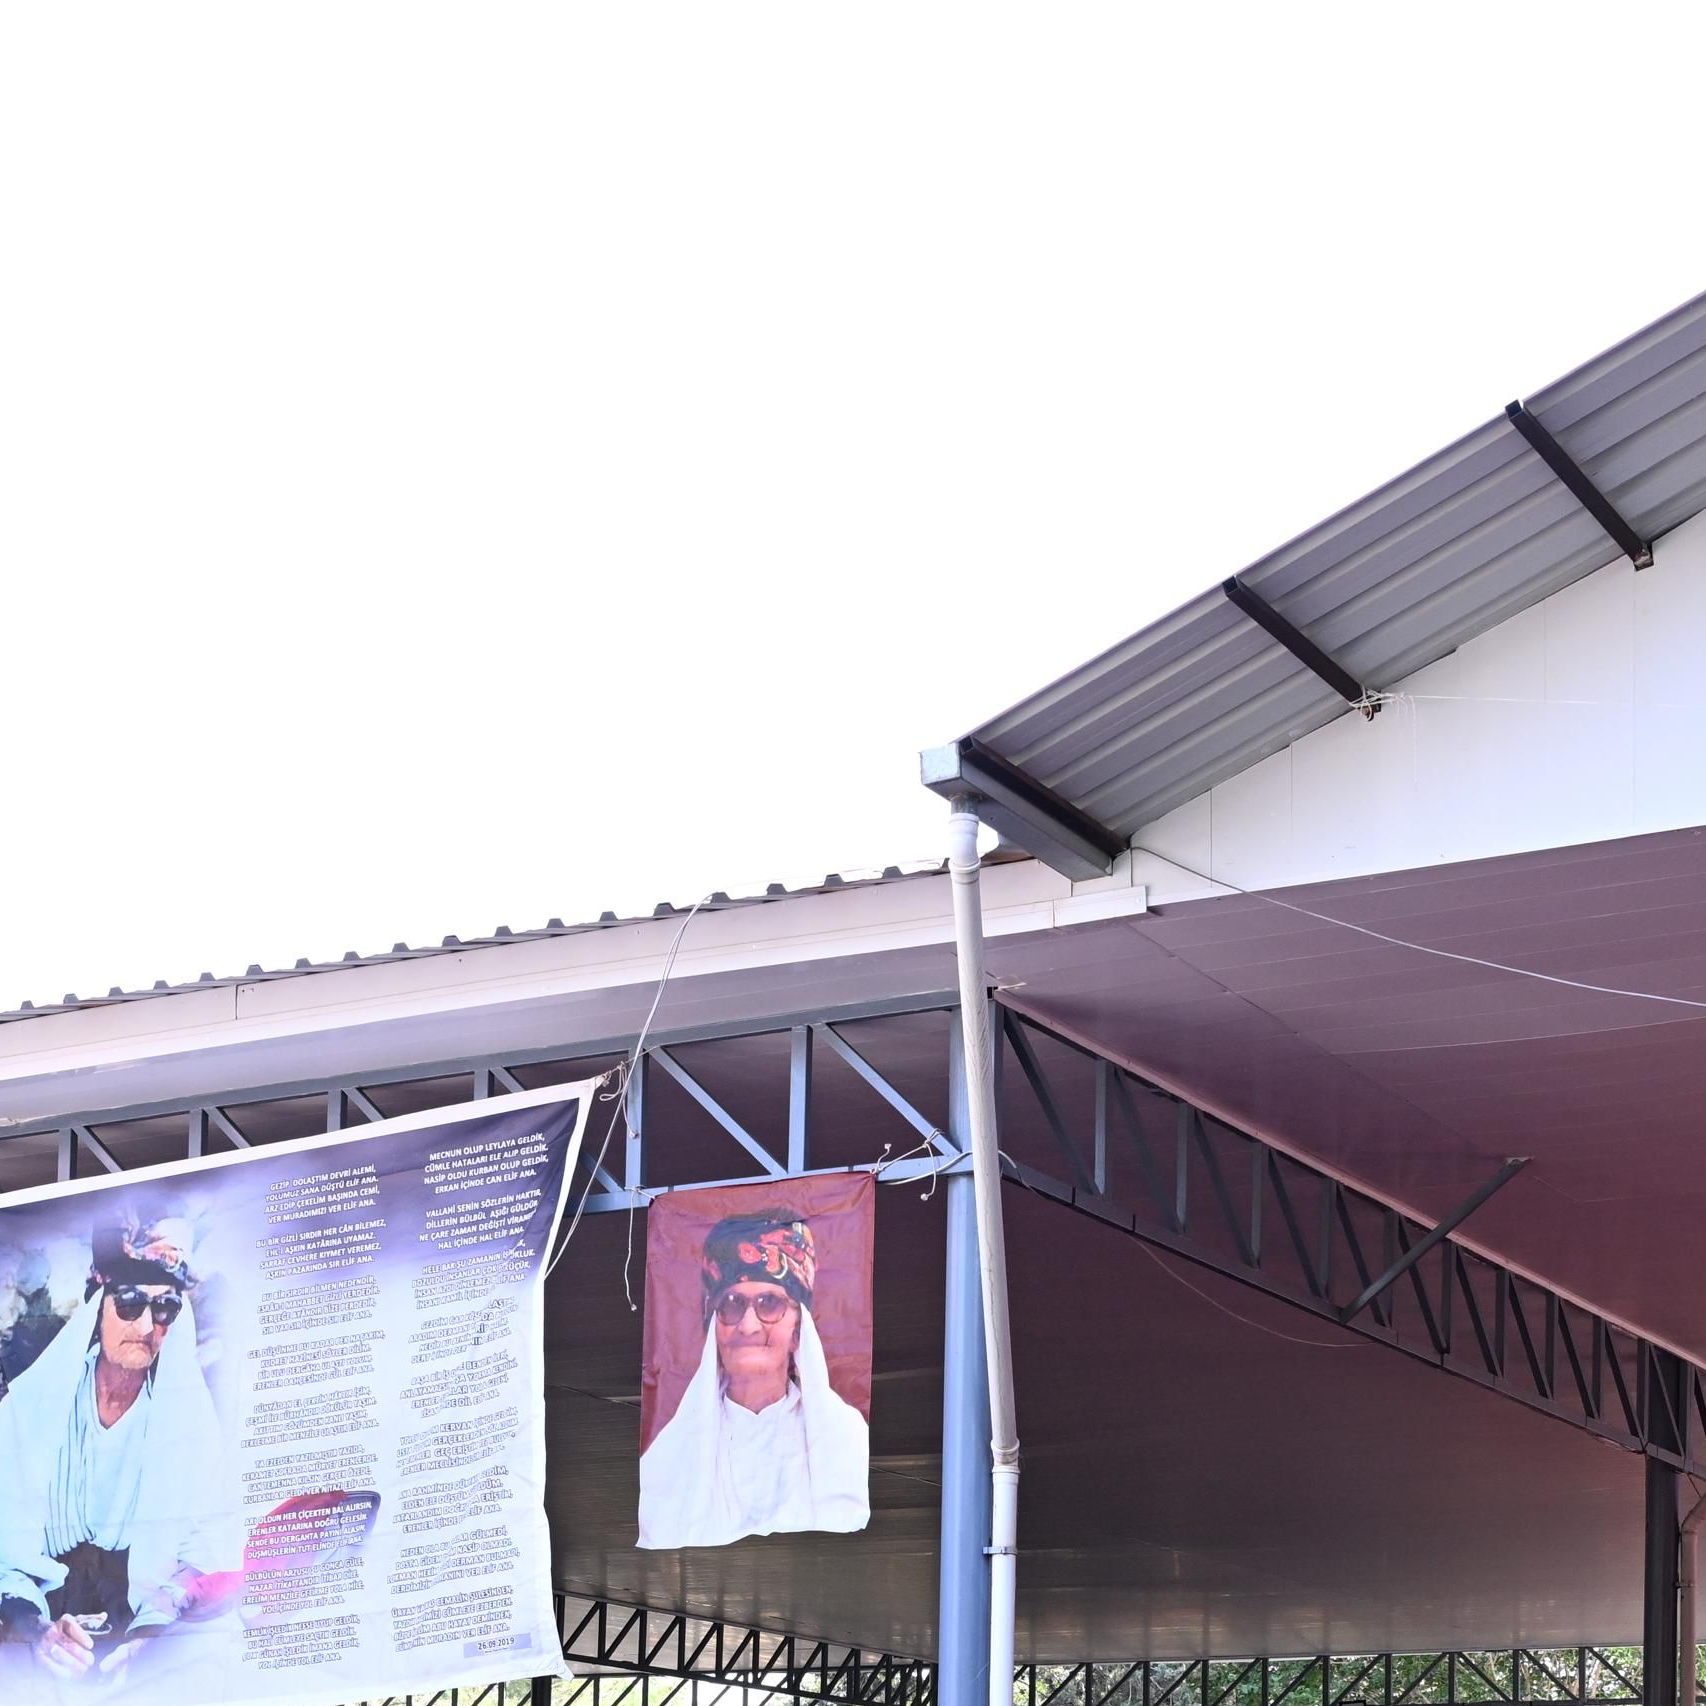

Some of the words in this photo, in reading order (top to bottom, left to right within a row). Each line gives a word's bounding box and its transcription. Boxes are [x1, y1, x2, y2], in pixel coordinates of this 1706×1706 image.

[424, 1160, 451, 1174] CÜMLE
[452, 1155, 488, 1168] HATALARI
[490, 1153, 502, 1162] ELE
[503, 1149, 519, 1159] ALIP
[520, 1142, 549, 1156] GELDİK.
[429, 1148, 462, 1162] MECNUN
[463, 1144, 484, 1155] OLUP
[485, 1139, 516, 1151] LEYLAYA
[517, 1131, 545, 1146] GELDİK,
[270, 1180, 290, 1191] GEZİP
[293, 1174, 328, 1188] DOLAŞTIM
[329, 1169, 351, 1180] DEVRİ
[352, 1164, 377, 1177] ALEMİ,
[424, 1173, 446, 1185] NASİP
[447, 1170, 468, 1180] OLDU
[469, 1165, 499, 1176] KURBAN
[500, 1161, 521, 1171] OLUP
[522, 1153, 549, 1167] GELDİK,
[435, 1183, 459, 1194] ERKAN
[460, 1177, 485, 1191] İÇİNDE
[486, 1175, 502, 1185] CAN
[503, 1170, 519, 1182] ELİF
[519, 1169, 537, 1179] ANA.
[265, 1205, 279, 1213] ARZ
[280, 1201, 296, 1211] EDİP
[297, 1195, 326, 1209] ÇEKELİM
[327, 1191, 359, 1204] BAŞINDA
[360, 1185, 381, 1197] CEMİ,
[266, 1190, 300, 1202] YOLUMUZ
[300, 1187, 320, 1196] SANA
[321, 1181, 345, 1194] DÜŞTÜ
[346, 1178, 360, 1188] ELİF
[360, 1176, 379, 1185] ANA.
[269, 1215, 283, 1224] VER
[283, 1207, 327, 1222] MURADIMIZI
[328, 1205, 342, 1214] VER
[343, 1200, 359, 1211] ELİF
[359, 1199, 377, 1209] ANA.
[426, 1205, 456, 1219] VALLAHİ
[457, 1201, 480, 1213] SENİN
[480, 1194, 514, 1208] SÖZLERİN
[426, 1215, 458, 1230] DİLLERİN
[459, 1210, 488, 1223] BÜLBÜL
[489, 1205, 509, 1219] AŞIĞI
[256, 1240, 267, 1248] BU
[268, 1236, 280, 1246] BİR
[281, 1233, 299, 1244] GİZLİ
[299, 1231, 322, 1241] SIRDIR
[323, 1228, 338, 1237] HER
[338, 1223, 354, 1235] CÂN
[355, 1218, 387, 1232] BİLEMEZ,
[419, 1234, 429, 1243] NE
[430, 1230, 450, 1242] ÇARE
[451, 1225, 478, 1237] ZAMAN
[479, 1217, 506, 1233] DEĞİŞTİ
[438, 1241, 453, 1251] HAL
[454, 1234, 479, 1249] İÇİNDE
[479, 1233, 494, 1243] HAL
[495, 1229, 509, 1240] ELİF
[285, 1244, 306, 1255] AŞKIN
[307, 1236, 343, 1250] KATÂRINA
[343, 1232, 376, 1245] UYAMAZ.
[286, 1253, 318, 1265] CEVHERE
[319, 1249, 346, 1260] KIYMET
[346, 1242, 382, 1255] VEREMEZ,
